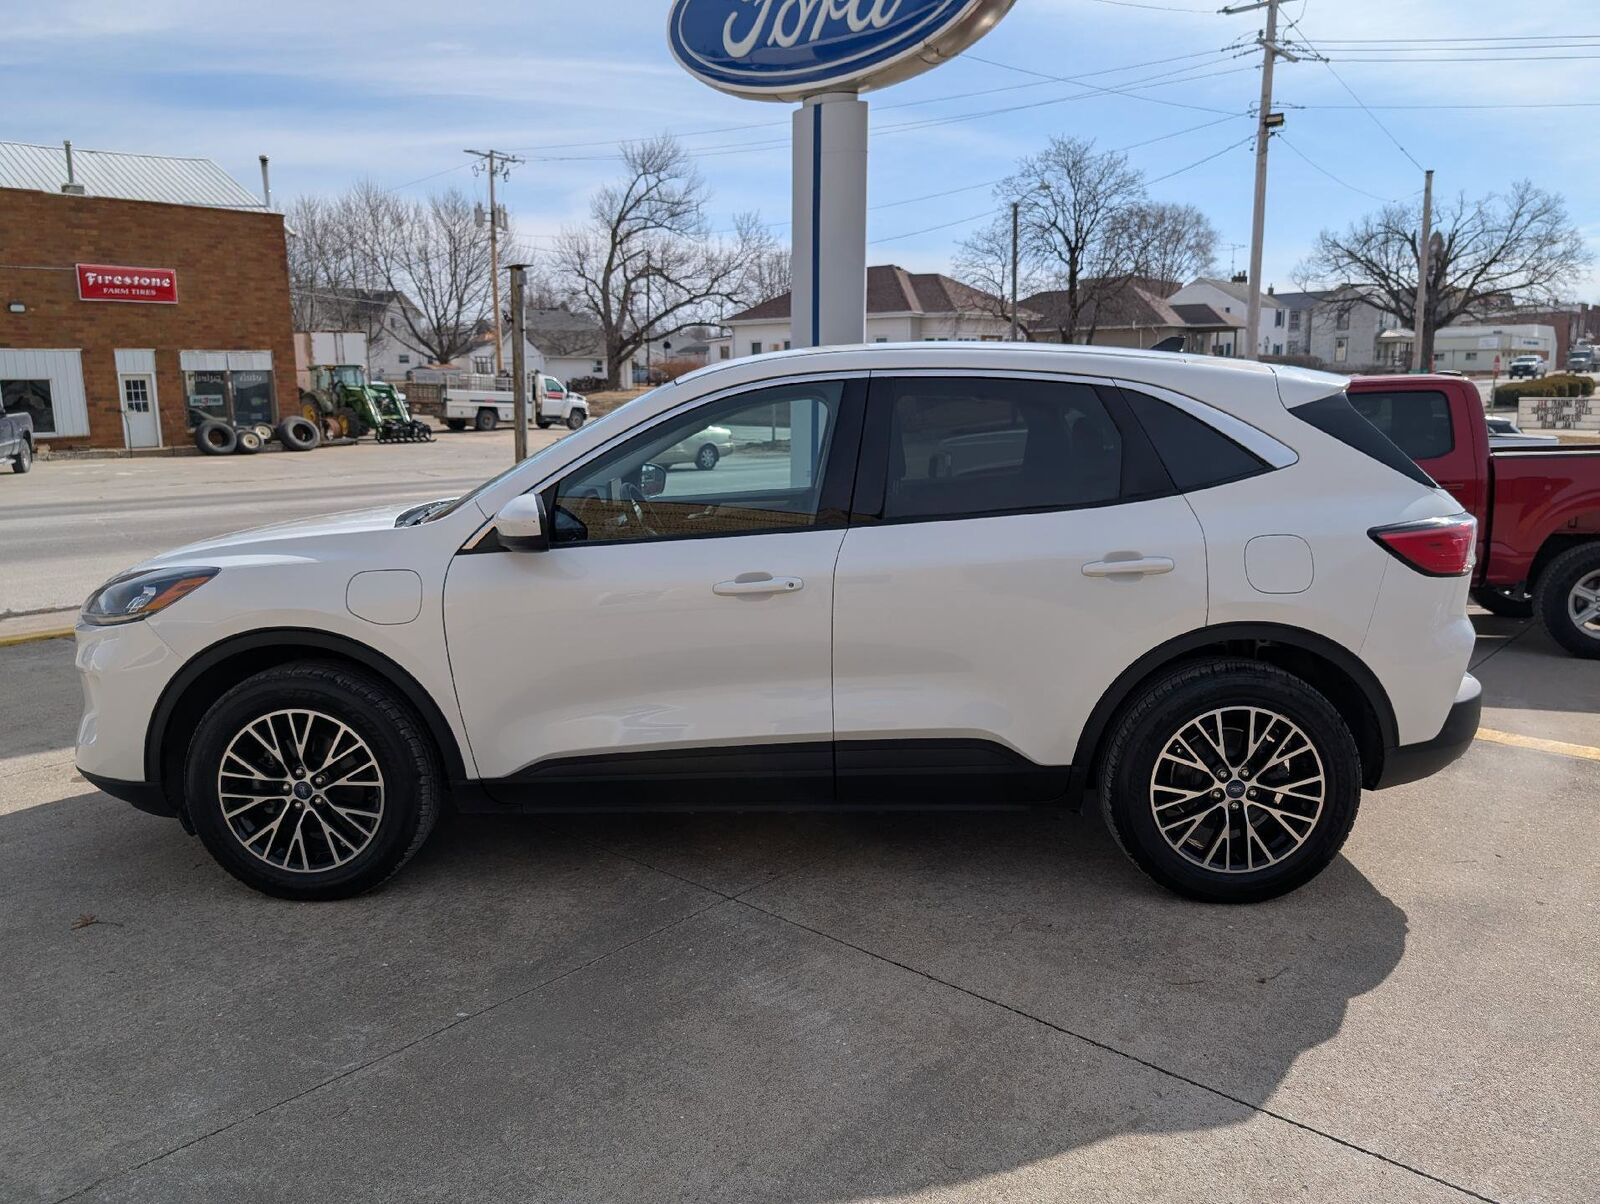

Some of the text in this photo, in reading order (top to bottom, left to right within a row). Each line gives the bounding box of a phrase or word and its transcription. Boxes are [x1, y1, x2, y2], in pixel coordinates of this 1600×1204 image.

[85, 272, 171, 287] Firestone
[103, 287, 156, 296] FARM TIRES
